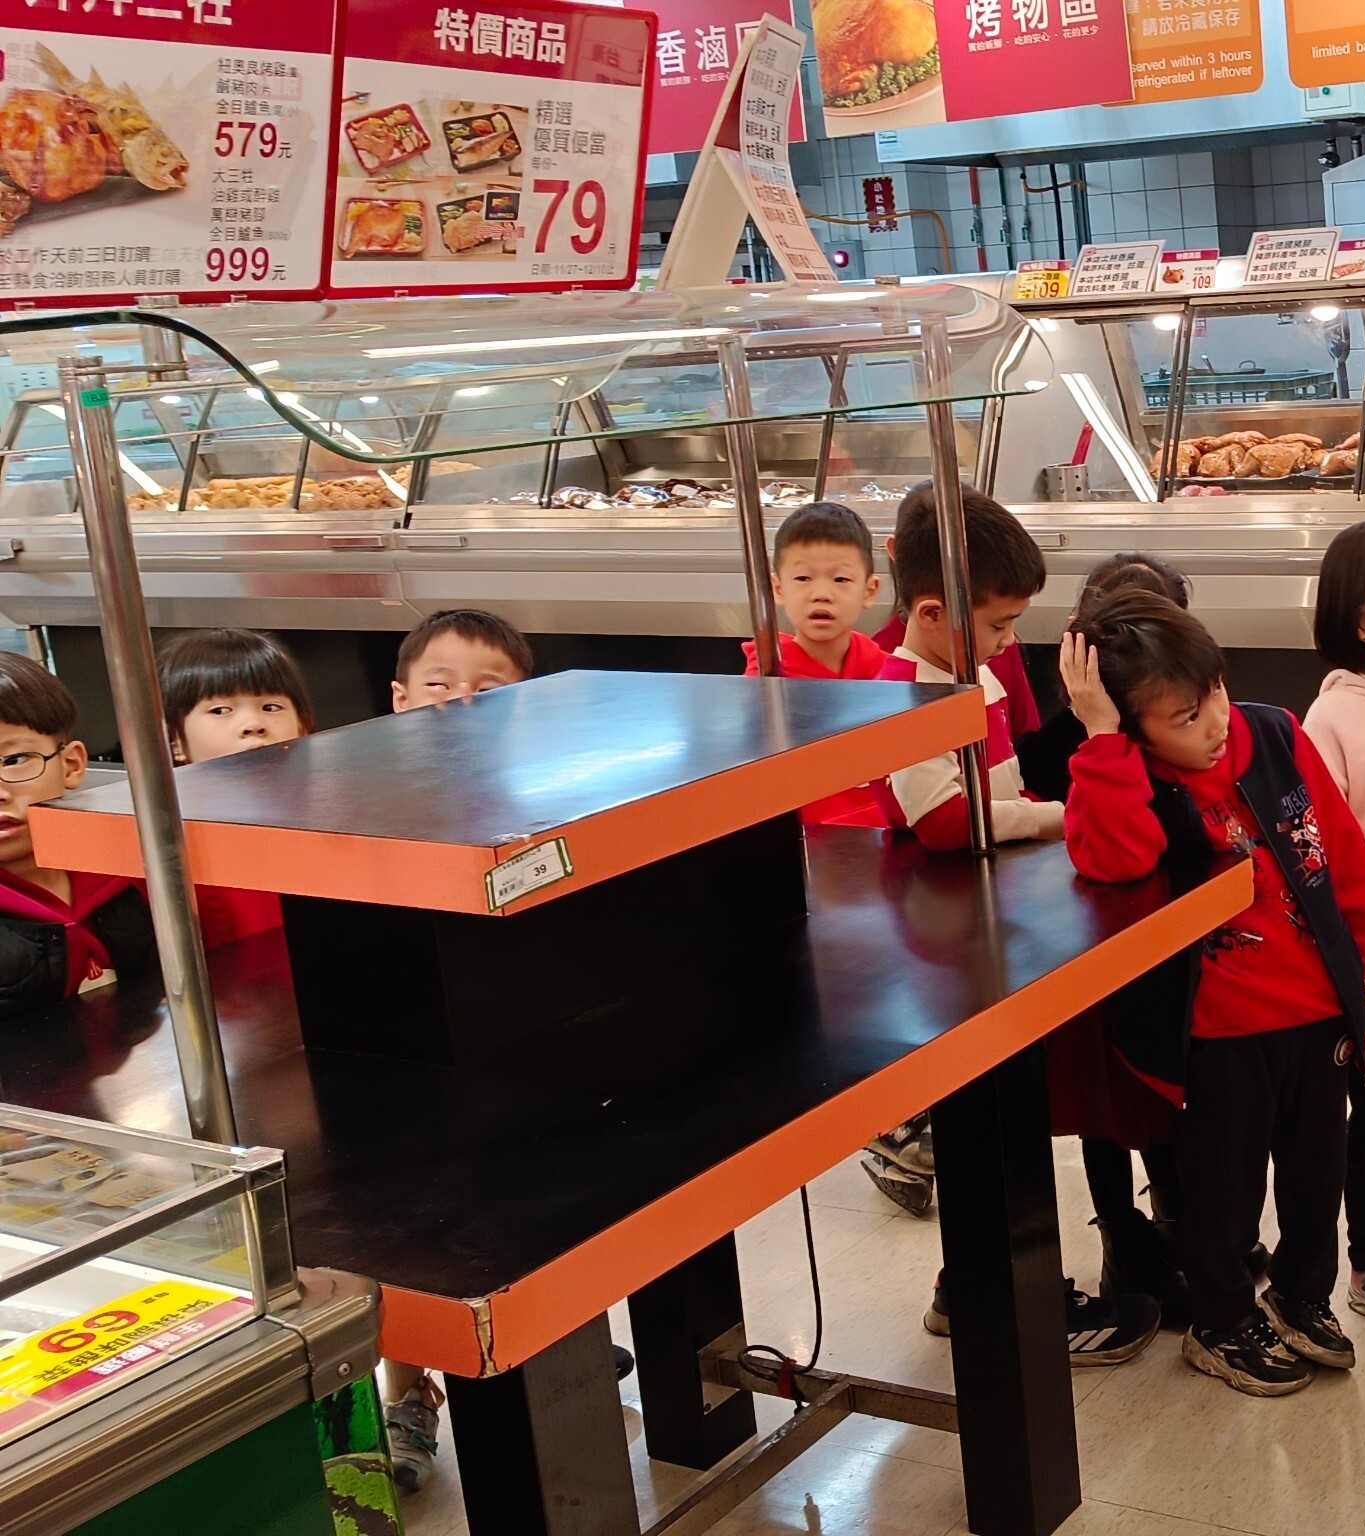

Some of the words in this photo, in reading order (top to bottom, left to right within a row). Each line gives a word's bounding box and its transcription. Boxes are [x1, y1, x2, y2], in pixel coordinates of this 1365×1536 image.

[433, 7, 567, 64] 特價商品
[1170, 54, 1203, 69] within
[1207, 52, 1216, 64] 3
[1220, 50, 1252, 63] hours
[1312, 42, 1351, 58] limited
[1134, 70, 1195, 89] refrigerated
[1200, 69, 1208, 80] if
[1212, 66, 1253, 79] leftover
[535, 99, 573, 126] 精選
[214, 121, 277, 158] 579
[278, 142, 292, 159] 元
[533, 127, 606, 156] 優質便當
[533, 178, 606, 255] 79
[205, 246, 269, 282] 999
[272, 265, 286, 281] 元
[1192, 275, 1211, 289] 109
[533, 864, 547, 876] 39
[37, 1310, 140, 1353] 69
